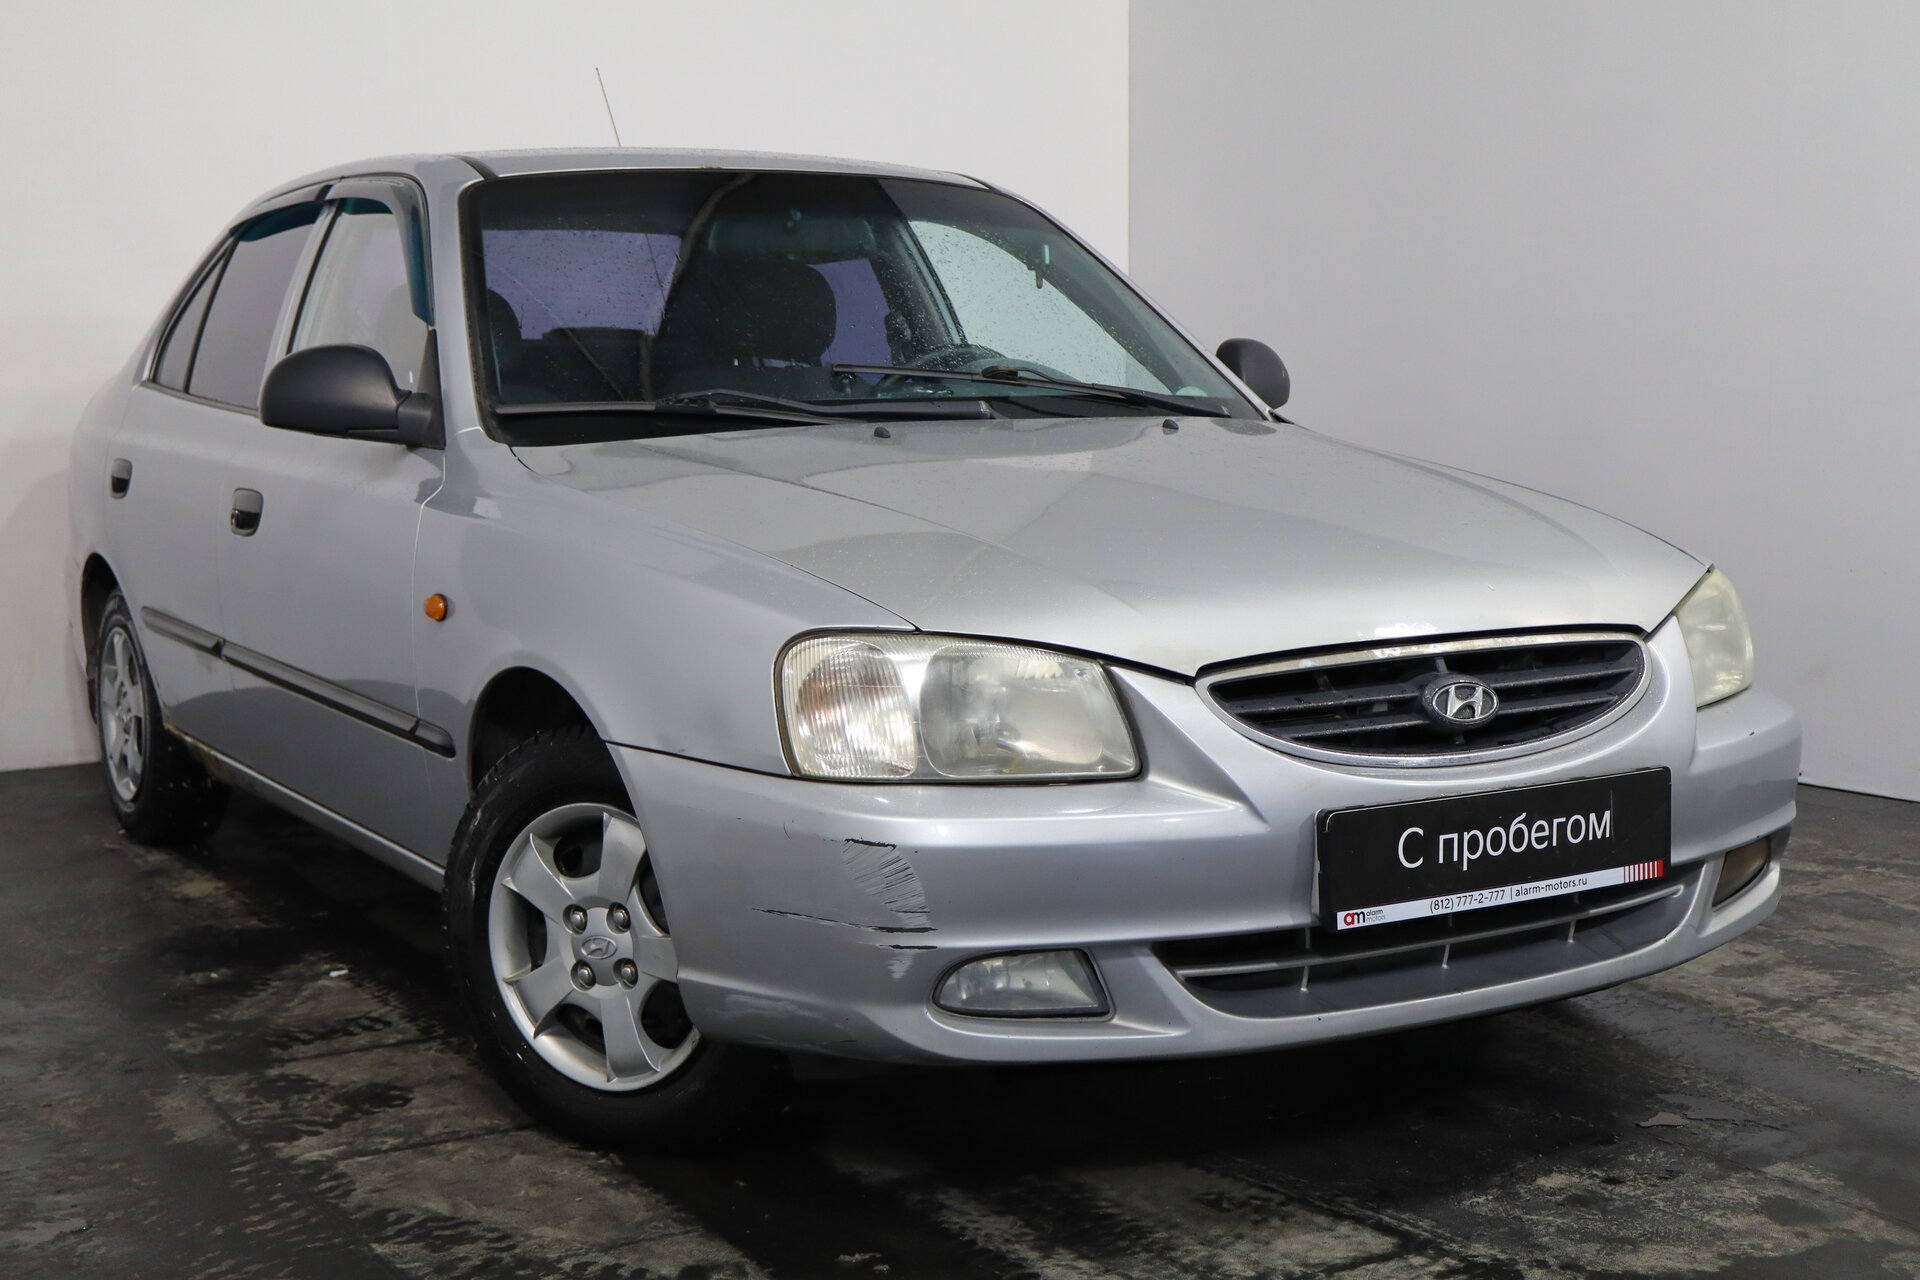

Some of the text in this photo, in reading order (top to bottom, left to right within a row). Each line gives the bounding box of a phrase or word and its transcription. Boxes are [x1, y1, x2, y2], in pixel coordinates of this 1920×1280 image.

[1398, 809, 1612, 871] С пробегом
[1430, 877, 1588, 914] (812) 777-2-777 alarm-motors.ru
